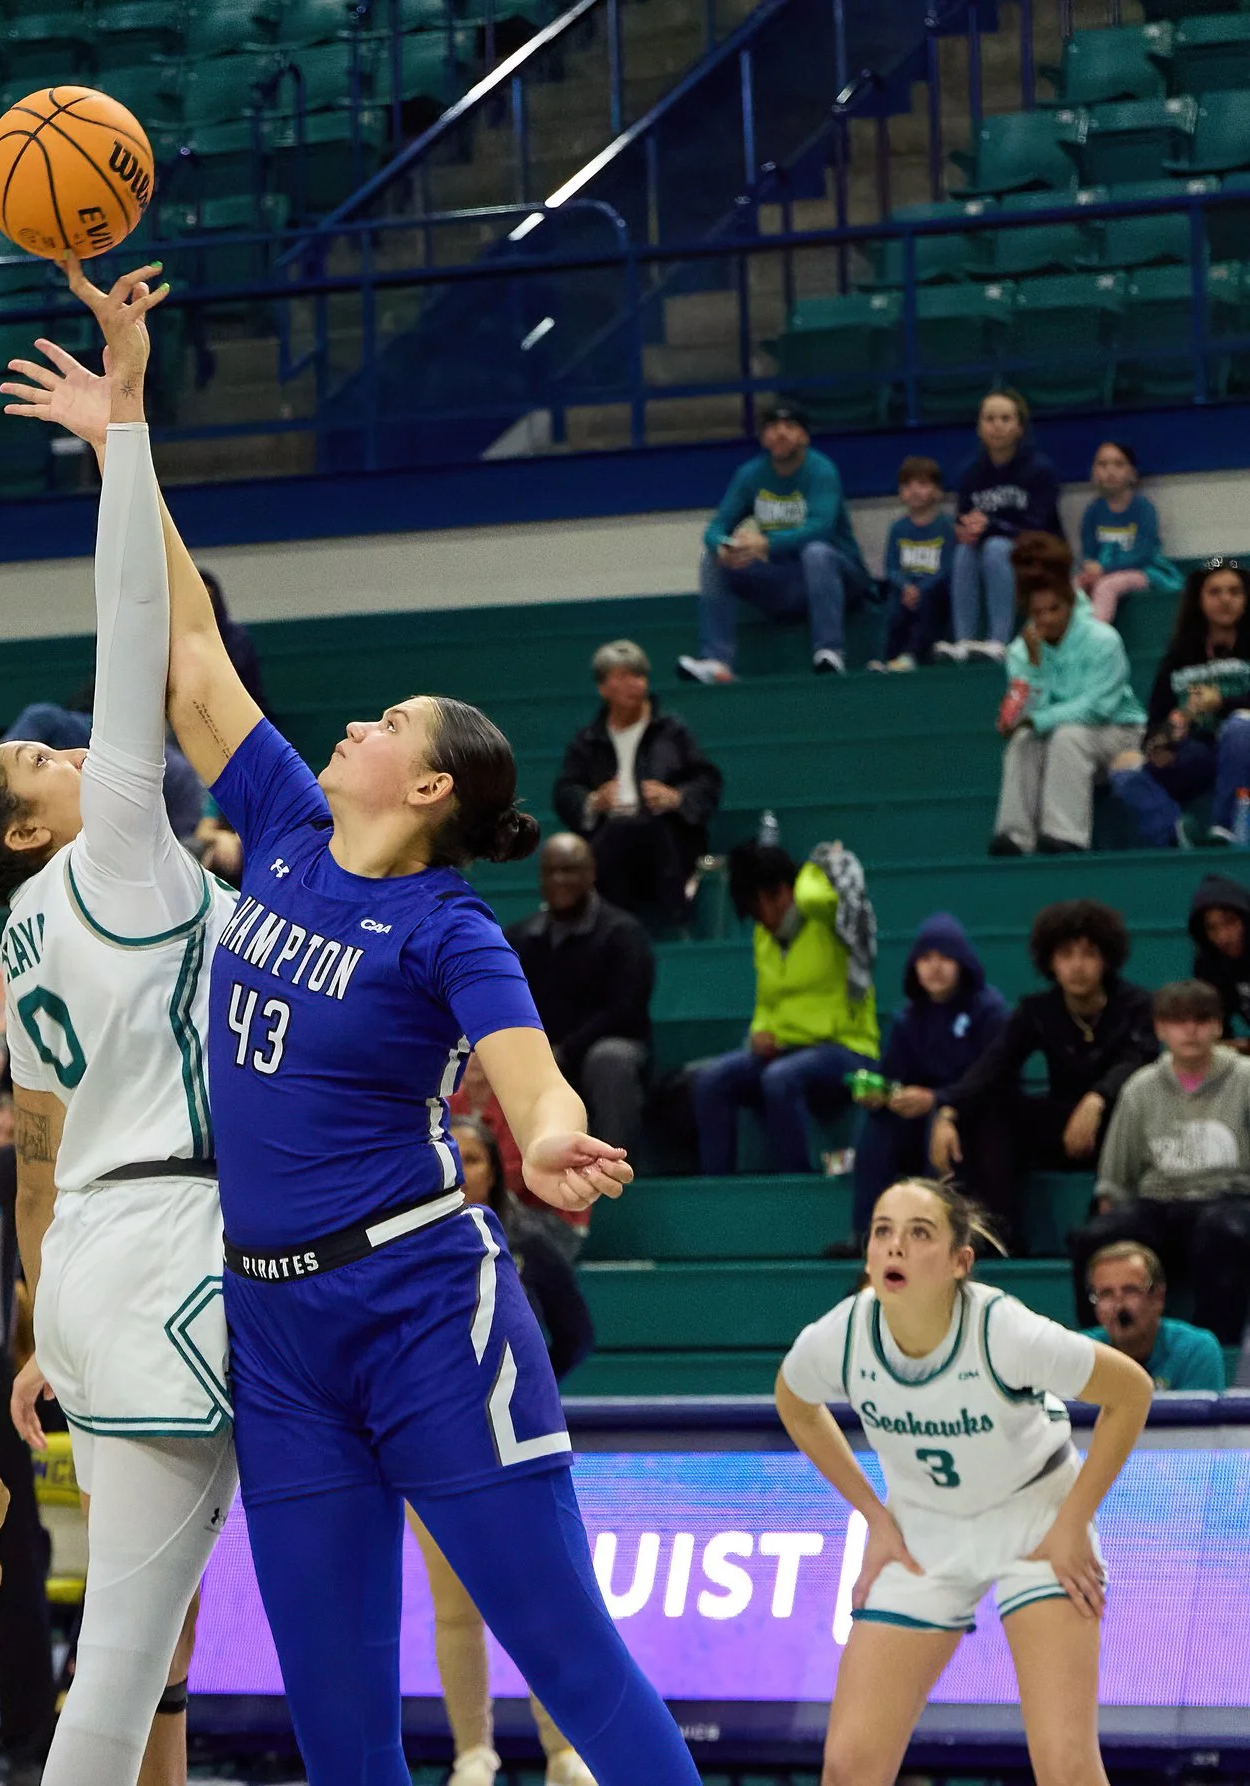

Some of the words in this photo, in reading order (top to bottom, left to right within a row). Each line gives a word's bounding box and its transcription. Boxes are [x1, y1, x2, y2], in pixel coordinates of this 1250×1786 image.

[220, 896, 364, 1000] HAMPTON
[360, 918, 393, 935] CAA
[17, 985, 88, 1089] 0
[228, 983, 291, 1075] 43
[242, 1250, 320, 1279] PIRATES
[861, 1401, 994, 1437] Seahawks
[916, 1447, 961, 1489] 3
[592, 1530, 825, 1620] UIST
